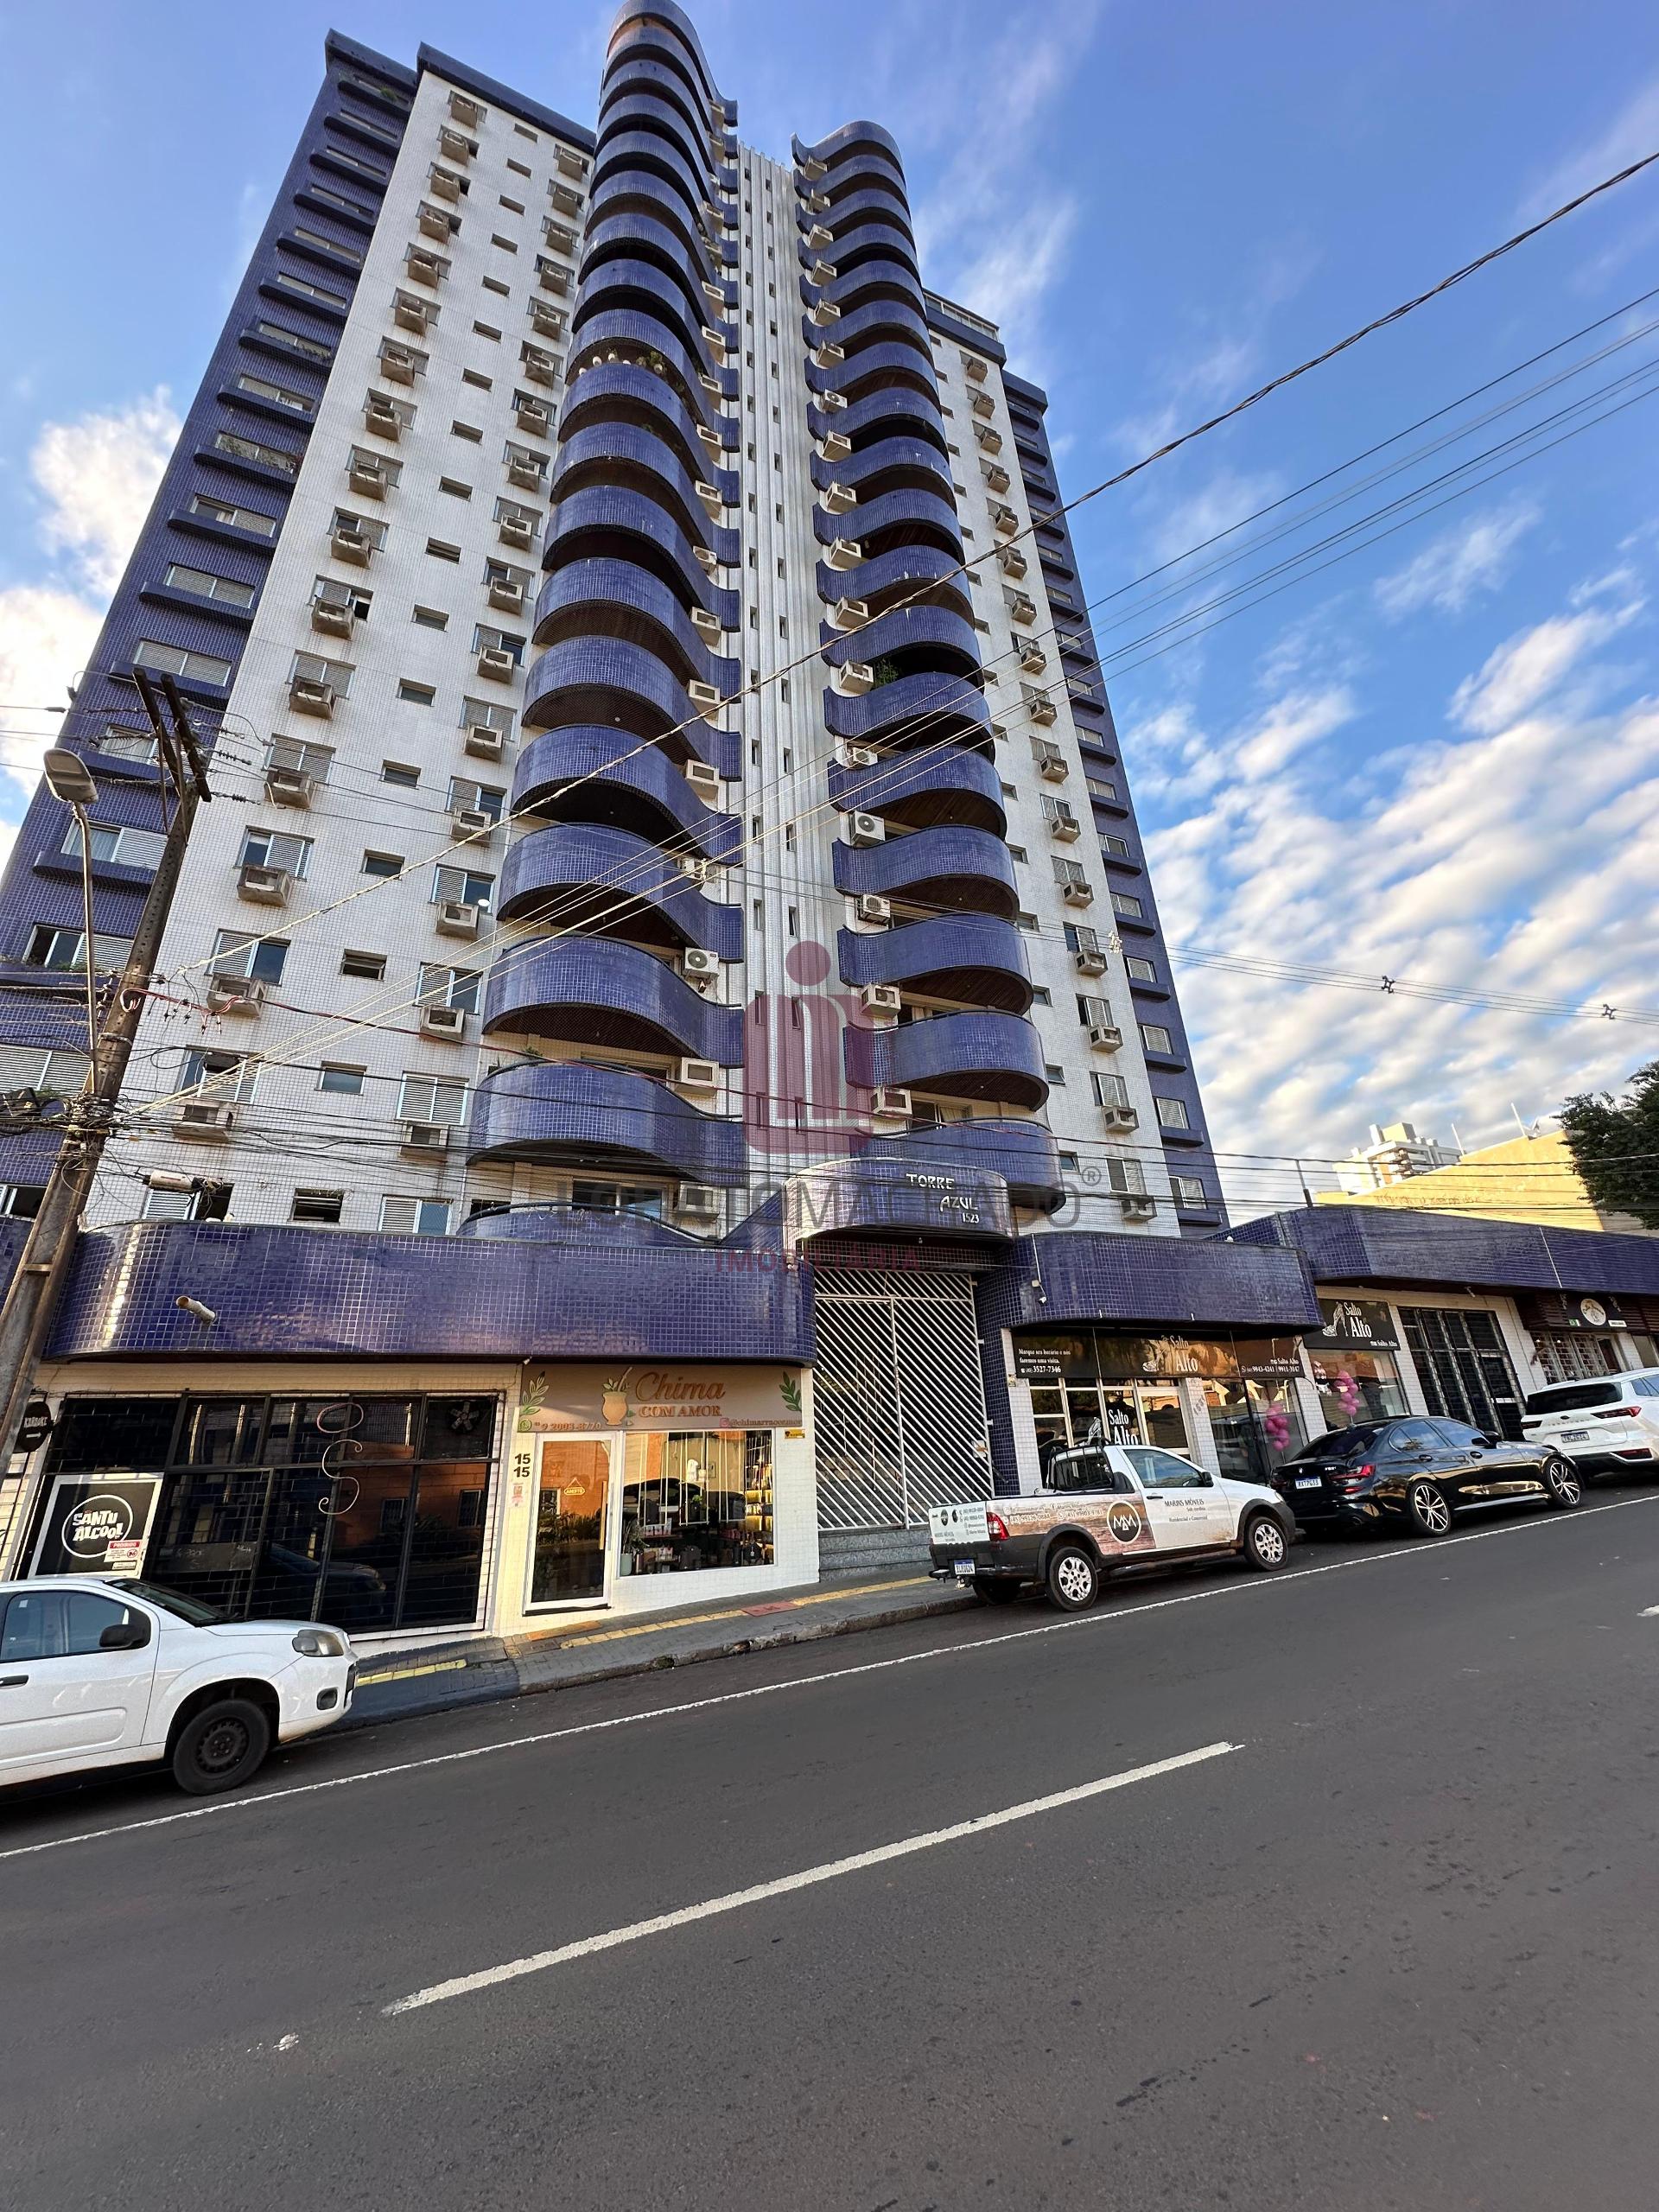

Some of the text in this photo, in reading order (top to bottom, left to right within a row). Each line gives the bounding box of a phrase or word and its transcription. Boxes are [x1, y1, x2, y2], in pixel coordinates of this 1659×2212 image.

[906, 1173, 955, 1190] TORRE
[940, 1195, 979, 1211] AZUL
[962, 1212, 979, 1224] 1523
[1344, 1301, 1363, 1316] Salto
[1350, 1316, 1372, 1338] Alto
[1169, 1335, 1189, 1350] Salto
[1176, 1350, 1198, 1372] Alto
[636, 1372, 726, 1402] Chima
[677, 1405, 721, 1418] AMOR
[1108, 1408, 1129, 1425] Salto
[1114, 1426, 1139, 1446] Alto
[514, 1453, 531, 1465] 15
[513, 1466, 531, 1478] 15
